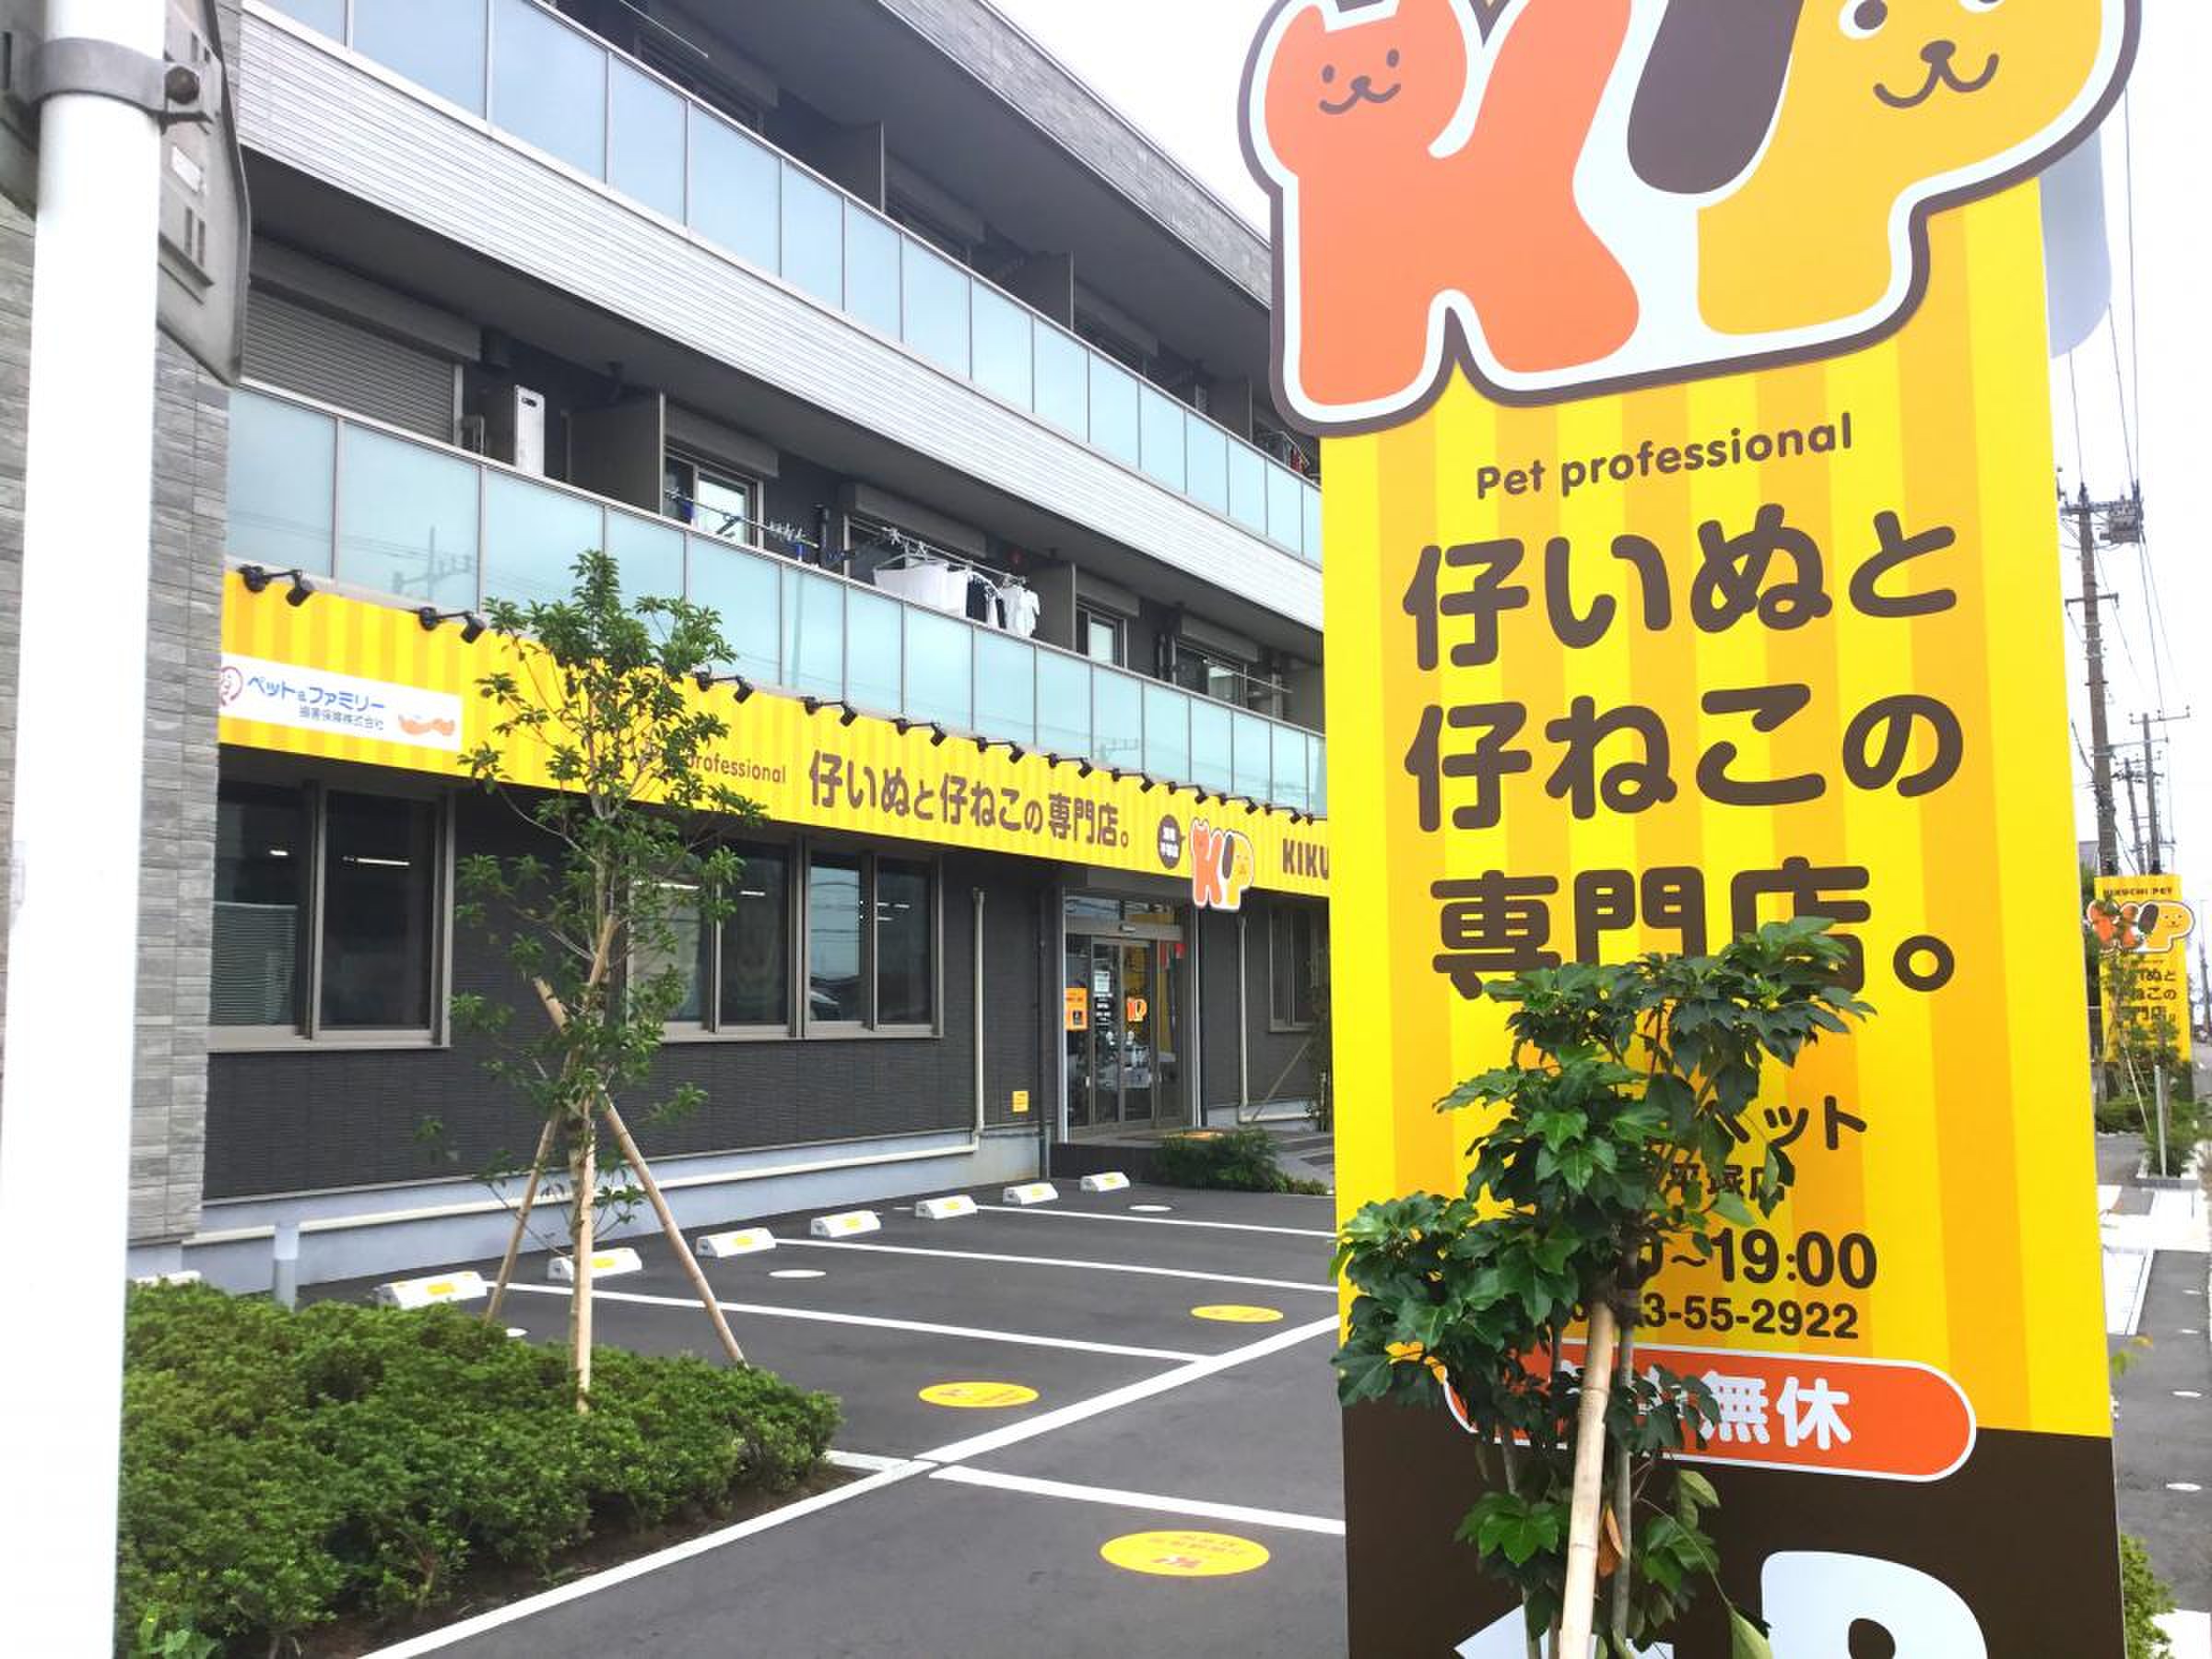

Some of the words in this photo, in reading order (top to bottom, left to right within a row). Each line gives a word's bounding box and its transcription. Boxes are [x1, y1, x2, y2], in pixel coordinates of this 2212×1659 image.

[1477, 461, 1546, 500] Pet
[1561, 412, 1853, 497] professional
[1403, 503, 1957, 672] 仔いぬと
[808, 749, 1130, 848] 仔いぬと仔ねこの専門店。
[1404, 683, 1964, 832] 仔ねこの
